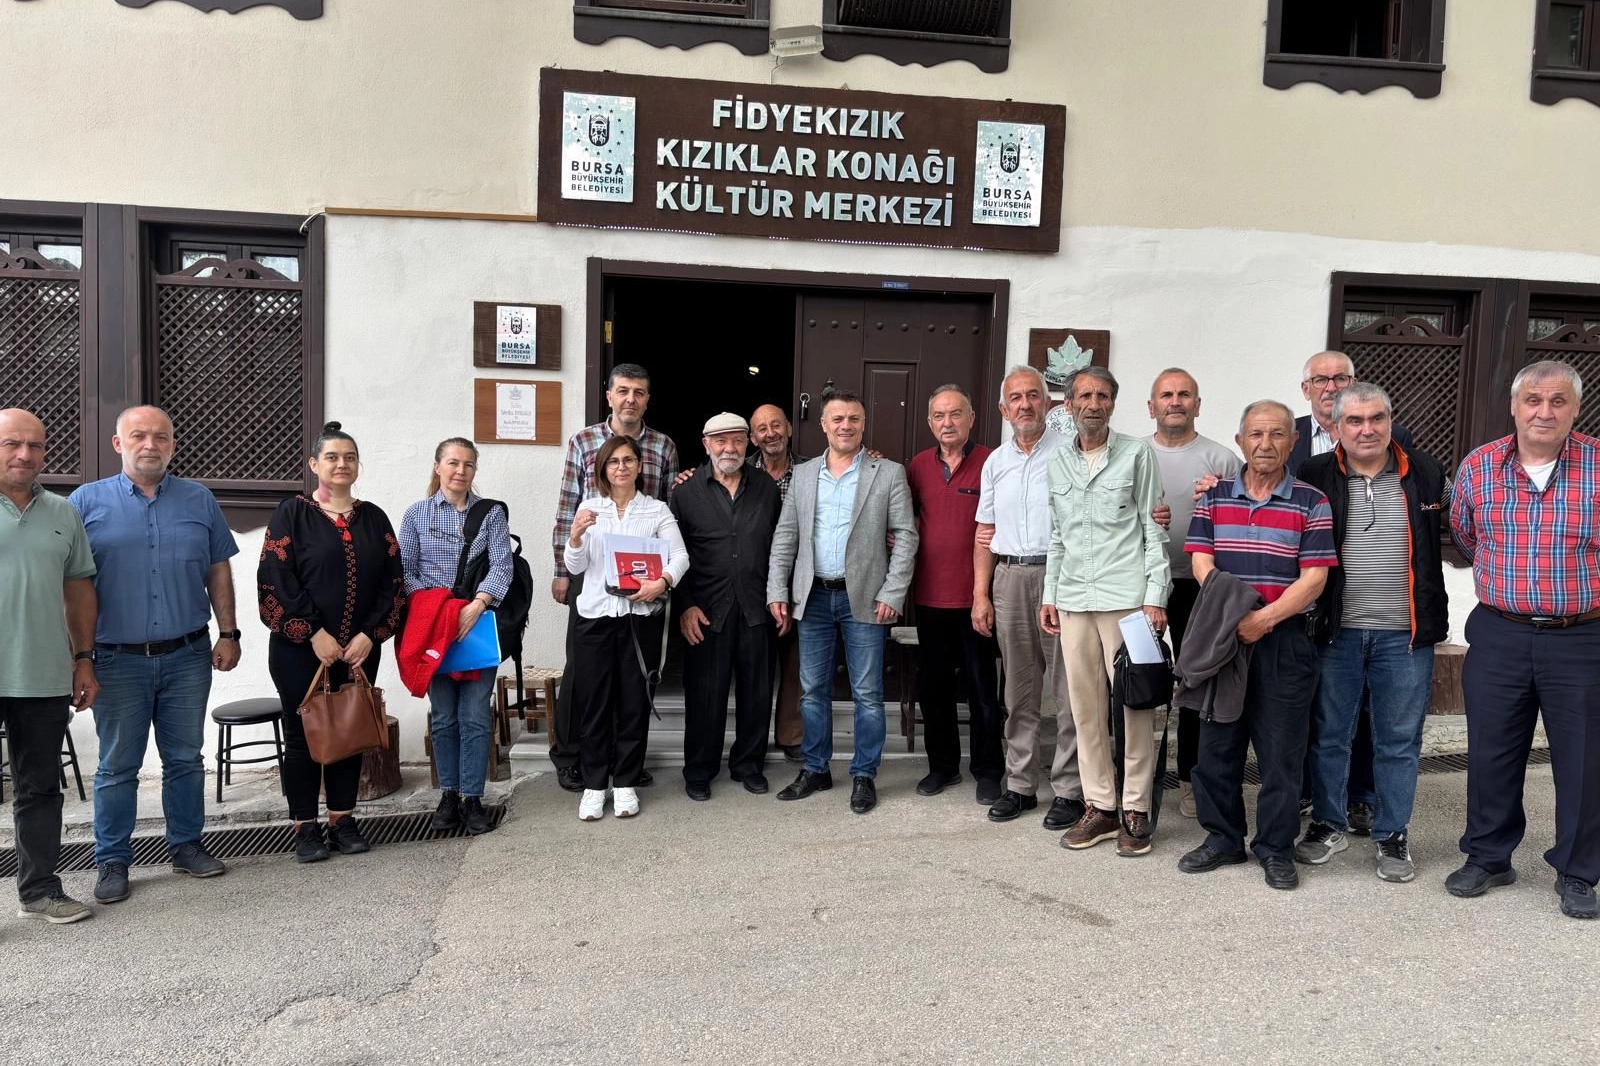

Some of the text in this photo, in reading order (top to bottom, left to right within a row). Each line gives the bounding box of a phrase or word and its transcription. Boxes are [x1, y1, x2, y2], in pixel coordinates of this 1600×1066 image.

[712, 94, 905, 140] FİDYEKIZIK
[656, 137, 955, 185] KIZIKLAR KONAĞI
[571, 160, 624, 176] BURSA
[571, 173, 624, 185] BÜYÜKŞEHİR
[571, 184, 624, 194] BELEDİYESİ
[982, 187, 1032, 201] BURSA
[656, 175, 953, 227] KÜLTÜR MERKEZİ
[982, 199, 1032, 210] BÜYÜKŞEHİR
[982, 209, 1032, 219] BELEDİYESİ
[501, 342, 531, 350] BURSA
